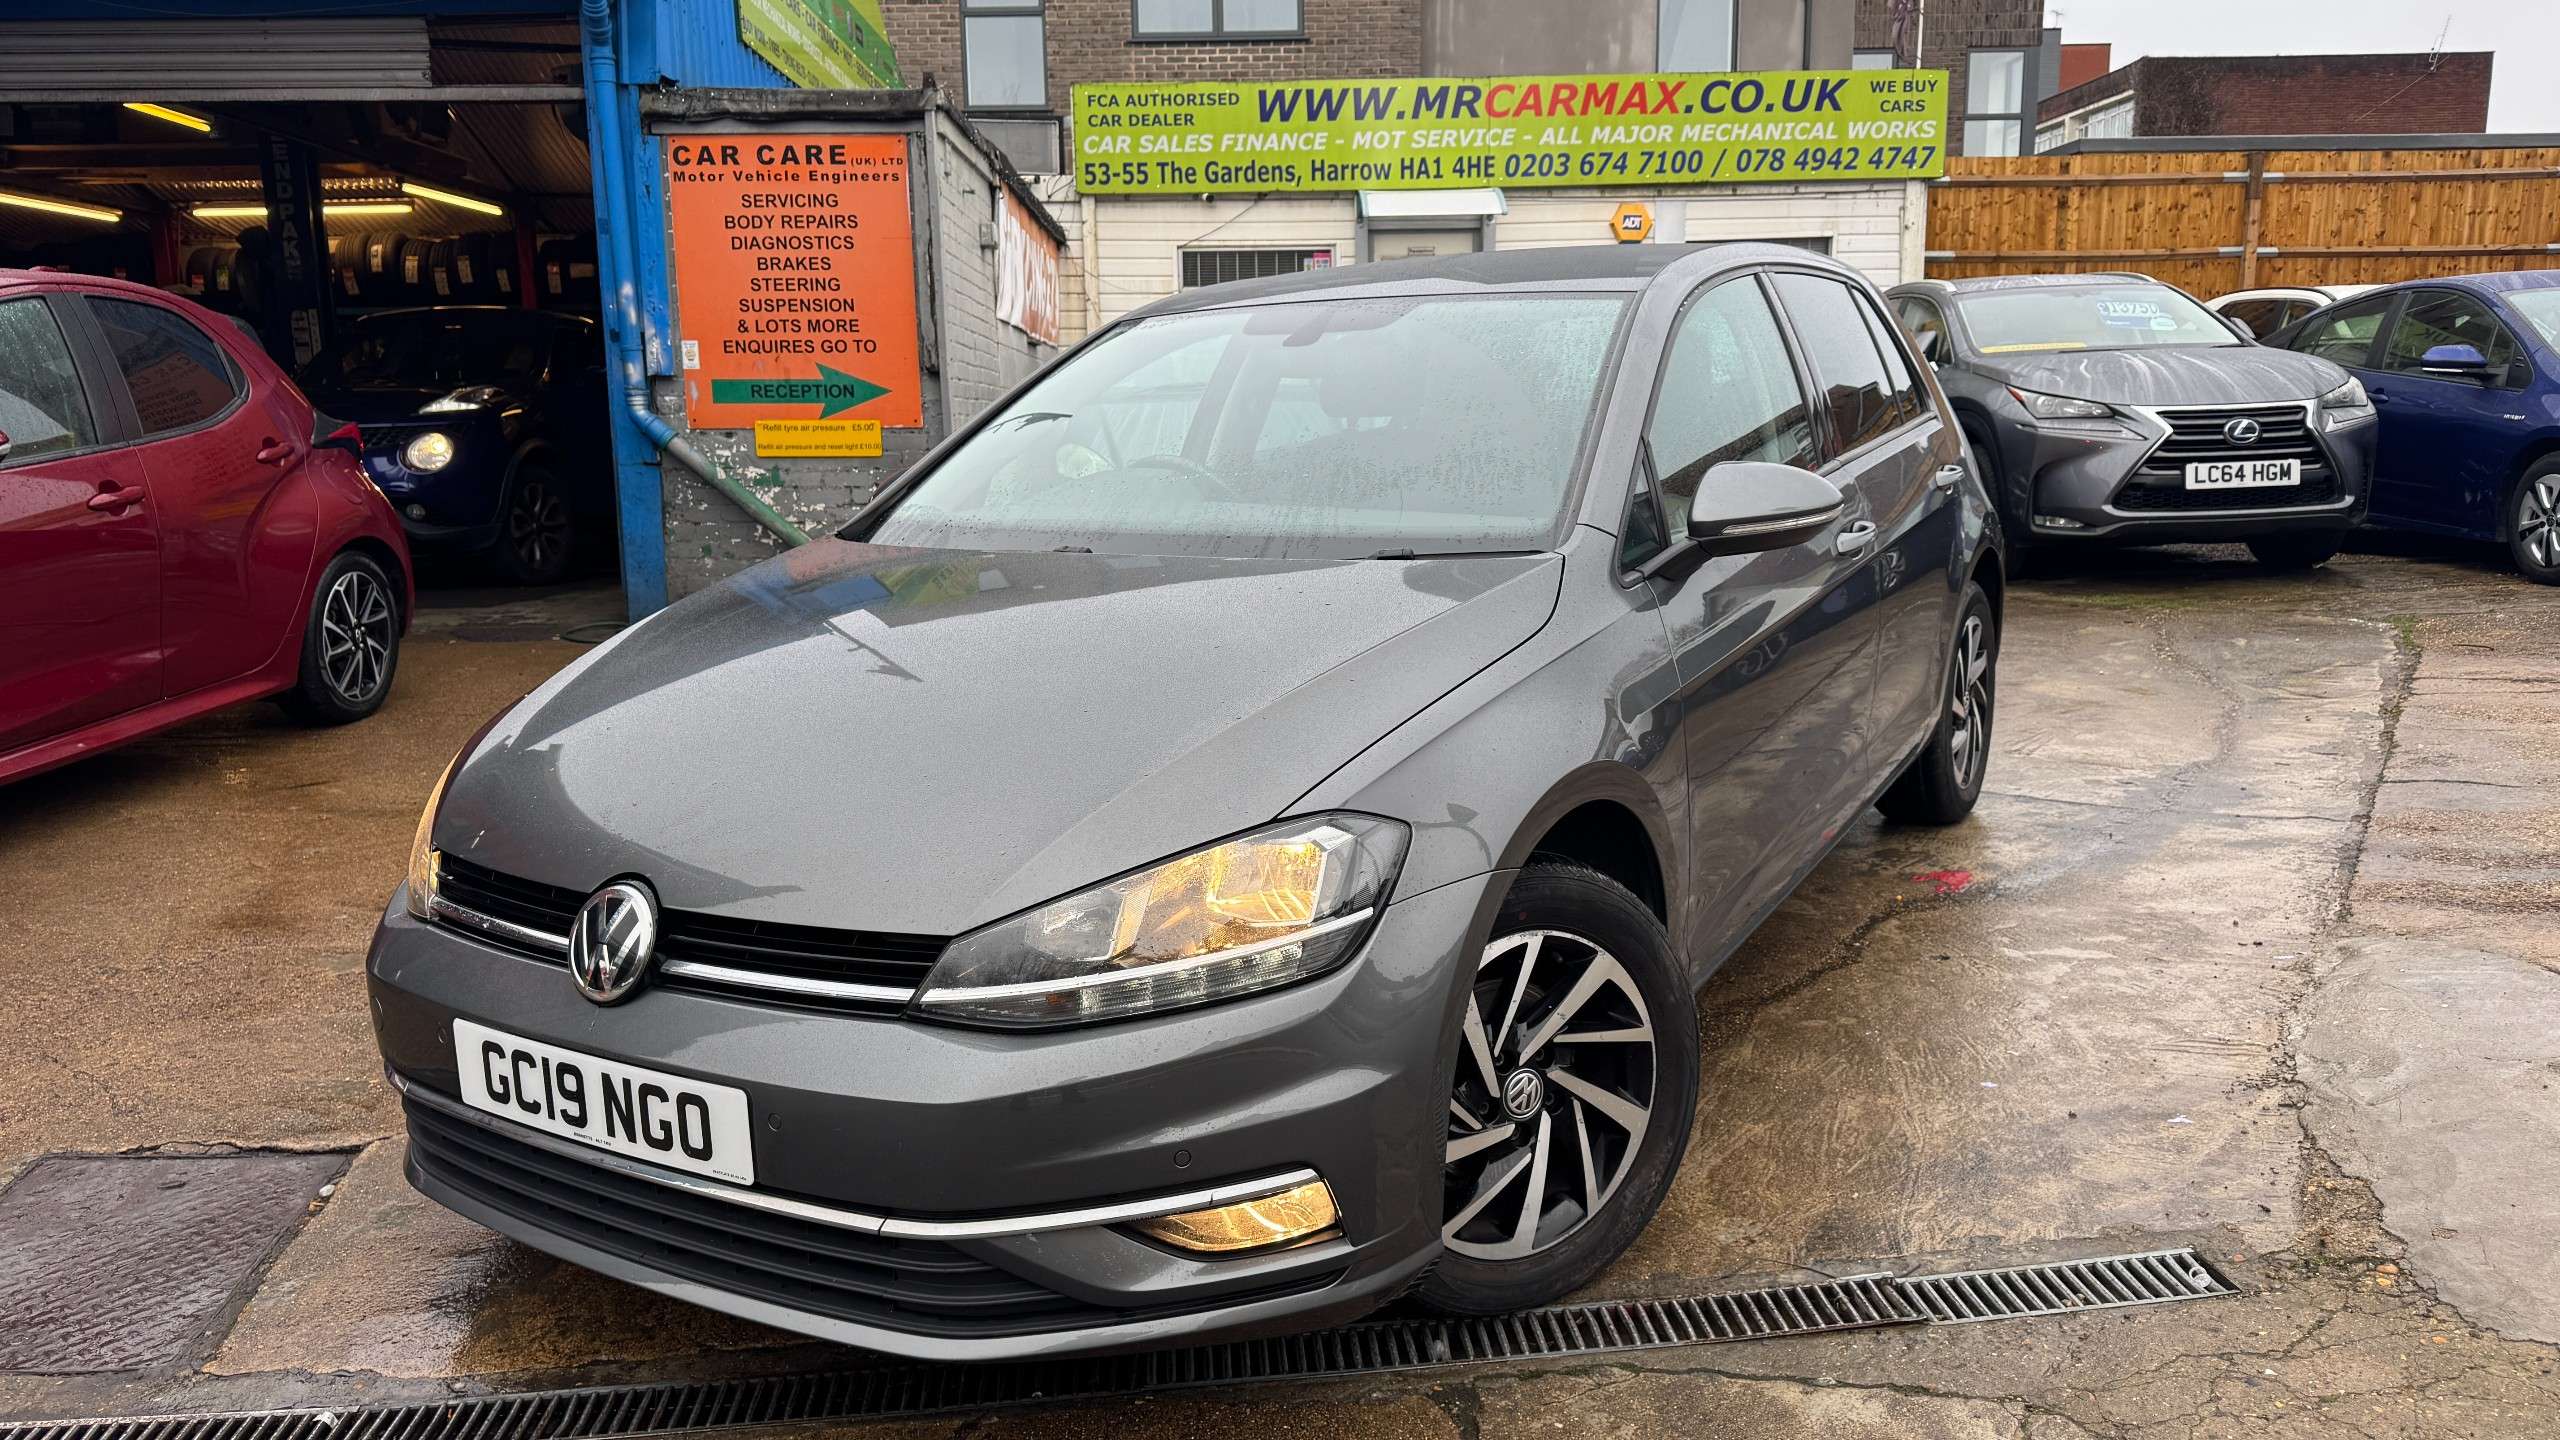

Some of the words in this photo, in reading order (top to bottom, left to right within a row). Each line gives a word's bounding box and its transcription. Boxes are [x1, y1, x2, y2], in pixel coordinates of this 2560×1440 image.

[1871, 81, 1896, 92] WE
[1904, 80, 1937, 92] BUY
[1088, 95, 1119, 107] FCA
[1126, 93, 1239, 106] AUTHORISED
[1258, 78, 1849, 123] WWW.MRCARMAX.CO.UK
[1881, 100, 1924, 112] CARS
[1089, 115, 1121, 127] CAR
[1129, 114, 1193, 126] DEALER
[1084, 136, 1131, 153] CAR
[1139, 134, 1213, 153] SALES
[1222, 132, 1328, 151] FINANCE
[1353, 130, 1406, 149] MOT
[1411, 128, 1516, 148] SERVICE
[1539, 127, 1581, 145] ALL
[1591, 125, 1673, 144] MAJOR
[1681, 123, 1836, 141] MECHANICAL
[1849, 120, 1936, 139] WORKS
[673, 146, 739, 166] CAR
[757, 145, 846, 165] CARE
[852, 158, 876, 167] (UK)
[883, 158, 904, 166] LTD
[1085, 163, 1148, 185] 53-55
[1157, 161, 1197, 184] The
[1205, 160, 1301, 186] Gardens,
[1312, 160, 1391, 181] Harrow
[1401, 157, 1442, 179] HA1
[1453, 156, 1494, 177] 4HE
[1505, 153, 1569, 177] 0203
[1580, 152, 1627, 175] 674
[1639, 151, 1702, 174] 7100
[1737, 149, 1785, 172] 078
[1794, 148, 1859, 170] 4942
[1869, 147, 1935, 169] 4747
[674, 172, 724, 181] Motor
[733, 171, 799, 181] Vehicle
[809, 171, 899, 184] Engineers
[271, 136, 302, 257] ENDPAK
[742, 194, 838, 208] SERVICING
[725, 215, 774, 229] BODY
[782, 215, 857, 228] REPAIRS
[1623, 215, 1642, 229] ADT
[732, 236, 854, 249] DIAGNOSTICS
[758, 257, 831, 270] BRAKES
[751, 278, 840, 291] STEERING
[740, 299, 854, 312] SUSPENSION
[738, 320, 749, 333] &
[756, 320, 801, 332] LOTS
[808, 319, 859, 332] MORE
[724, 340, 814, 354] ENQUIRES
[821, 340, 847, 353] GO
[853, 340, 876, 352] TO
[751, 384, 854, 398] RECEPTION
[784, 424, 798, 432] tyre
[2195, 465, 2246, 483] LC64
[2253, 463, 2292, 481] HGM
[481, 1040, 588, 1129] GC19
[601, 1072, 712, 1161] NGO
